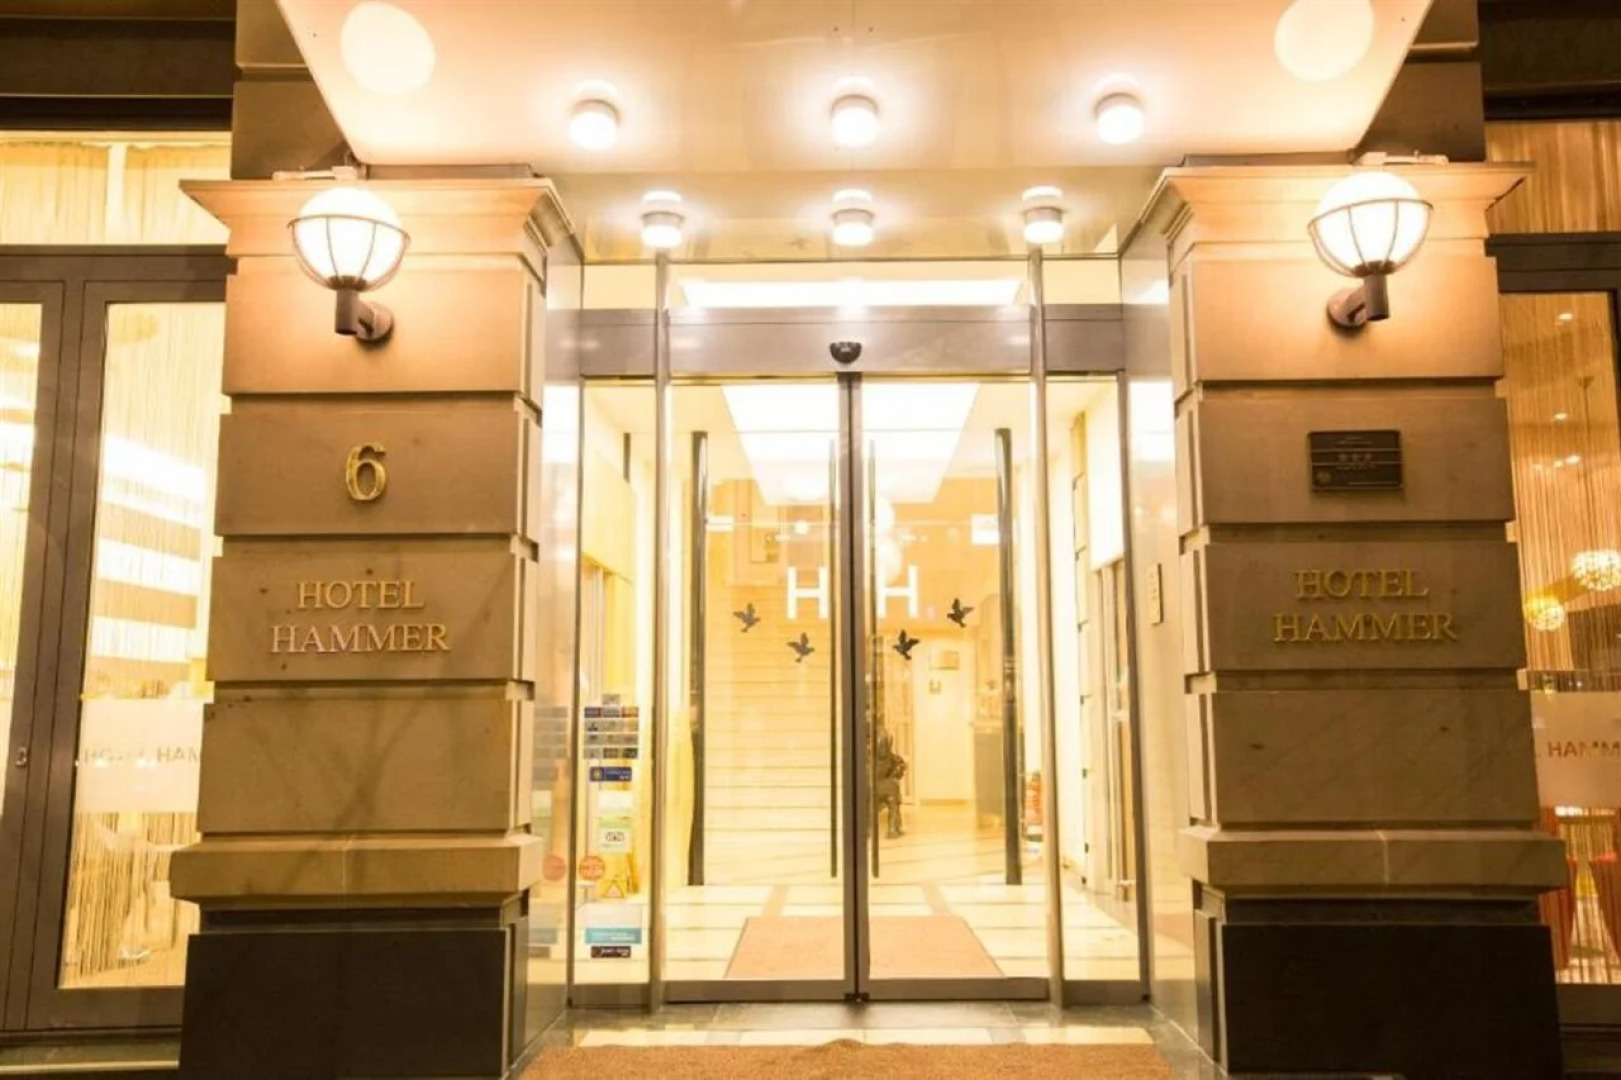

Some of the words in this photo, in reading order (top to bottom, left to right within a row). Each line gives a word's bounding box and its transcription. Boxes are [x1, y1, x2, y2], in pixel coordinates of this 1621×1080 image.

[346, 442, 386, 501] 6
[297, 579, 425, 610] HOTEL
[787, 566, 829, 620] H
[876, 564, 918, 618] H
[1294, 569, 1430, 599] HOTEL
[270, 622, 450, 654] HAMMER
[1273, 612, 1459, 643] HAMMER
